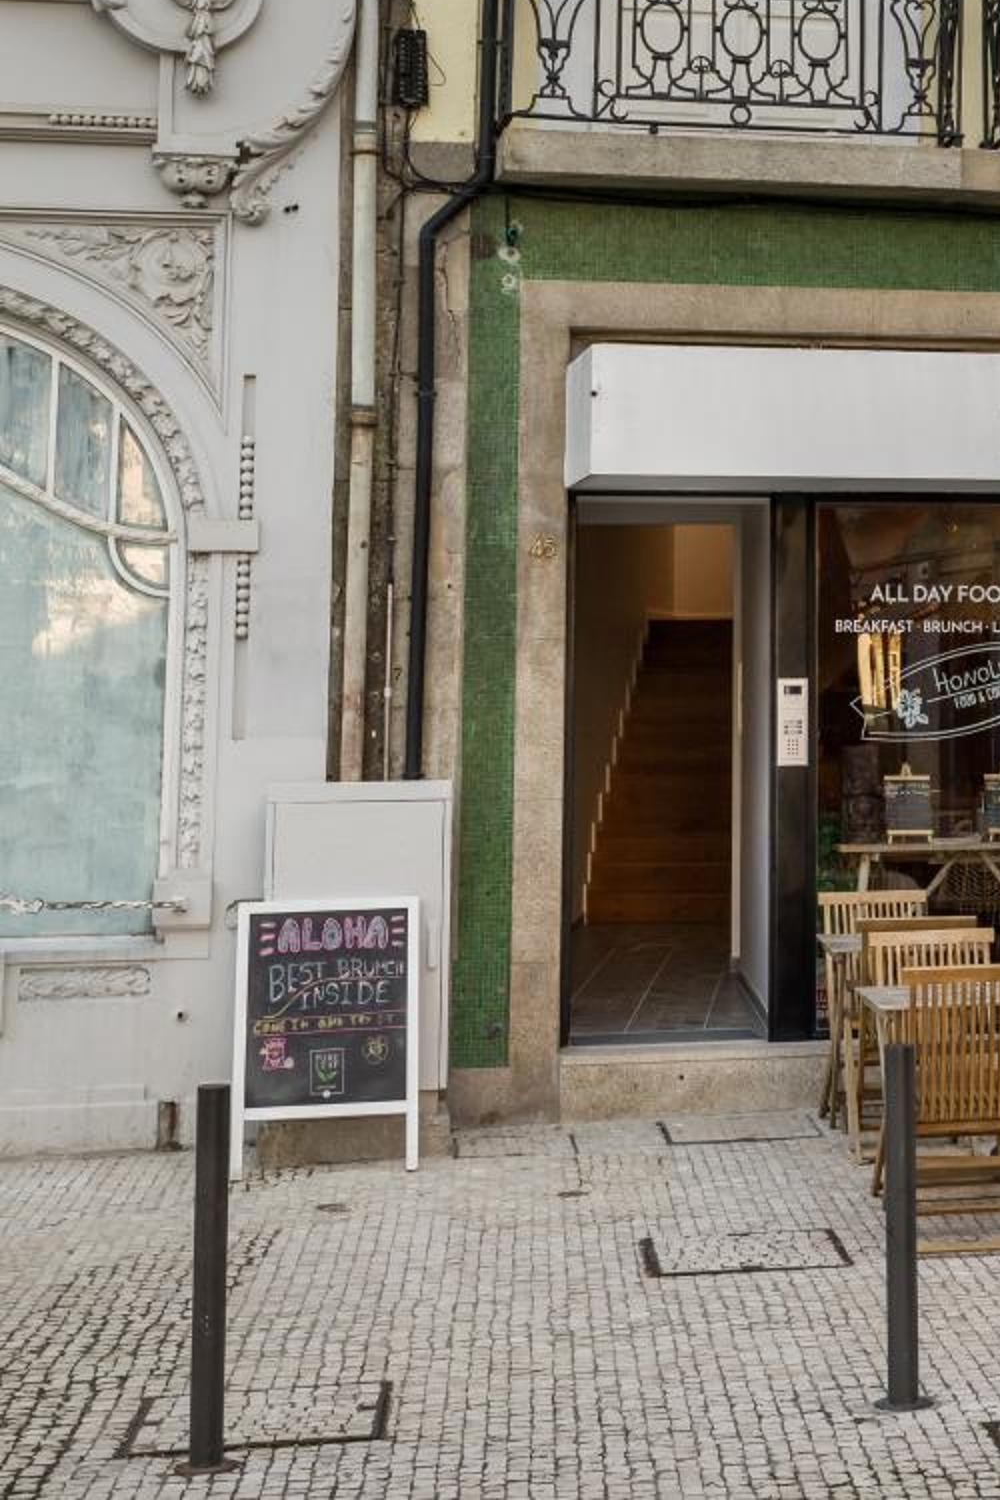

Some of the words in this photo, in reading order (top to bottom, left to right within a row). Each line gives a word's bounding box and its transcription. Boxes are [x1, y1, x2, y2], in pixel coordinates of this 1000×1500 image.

[870, 584, 909, 603] ALL
[913, 584, 953, 603] DAY
[835, 619, 913, 634] BREAKFAST
[923, 619, 983, 634] BRUNCH
[277, 915, 389, 953] ALOHA
[269, 961, 328, 1002] BEST
[336, 957, 404, 980] BRUNCH
[301, 981, 391, 1010] INSIDE
